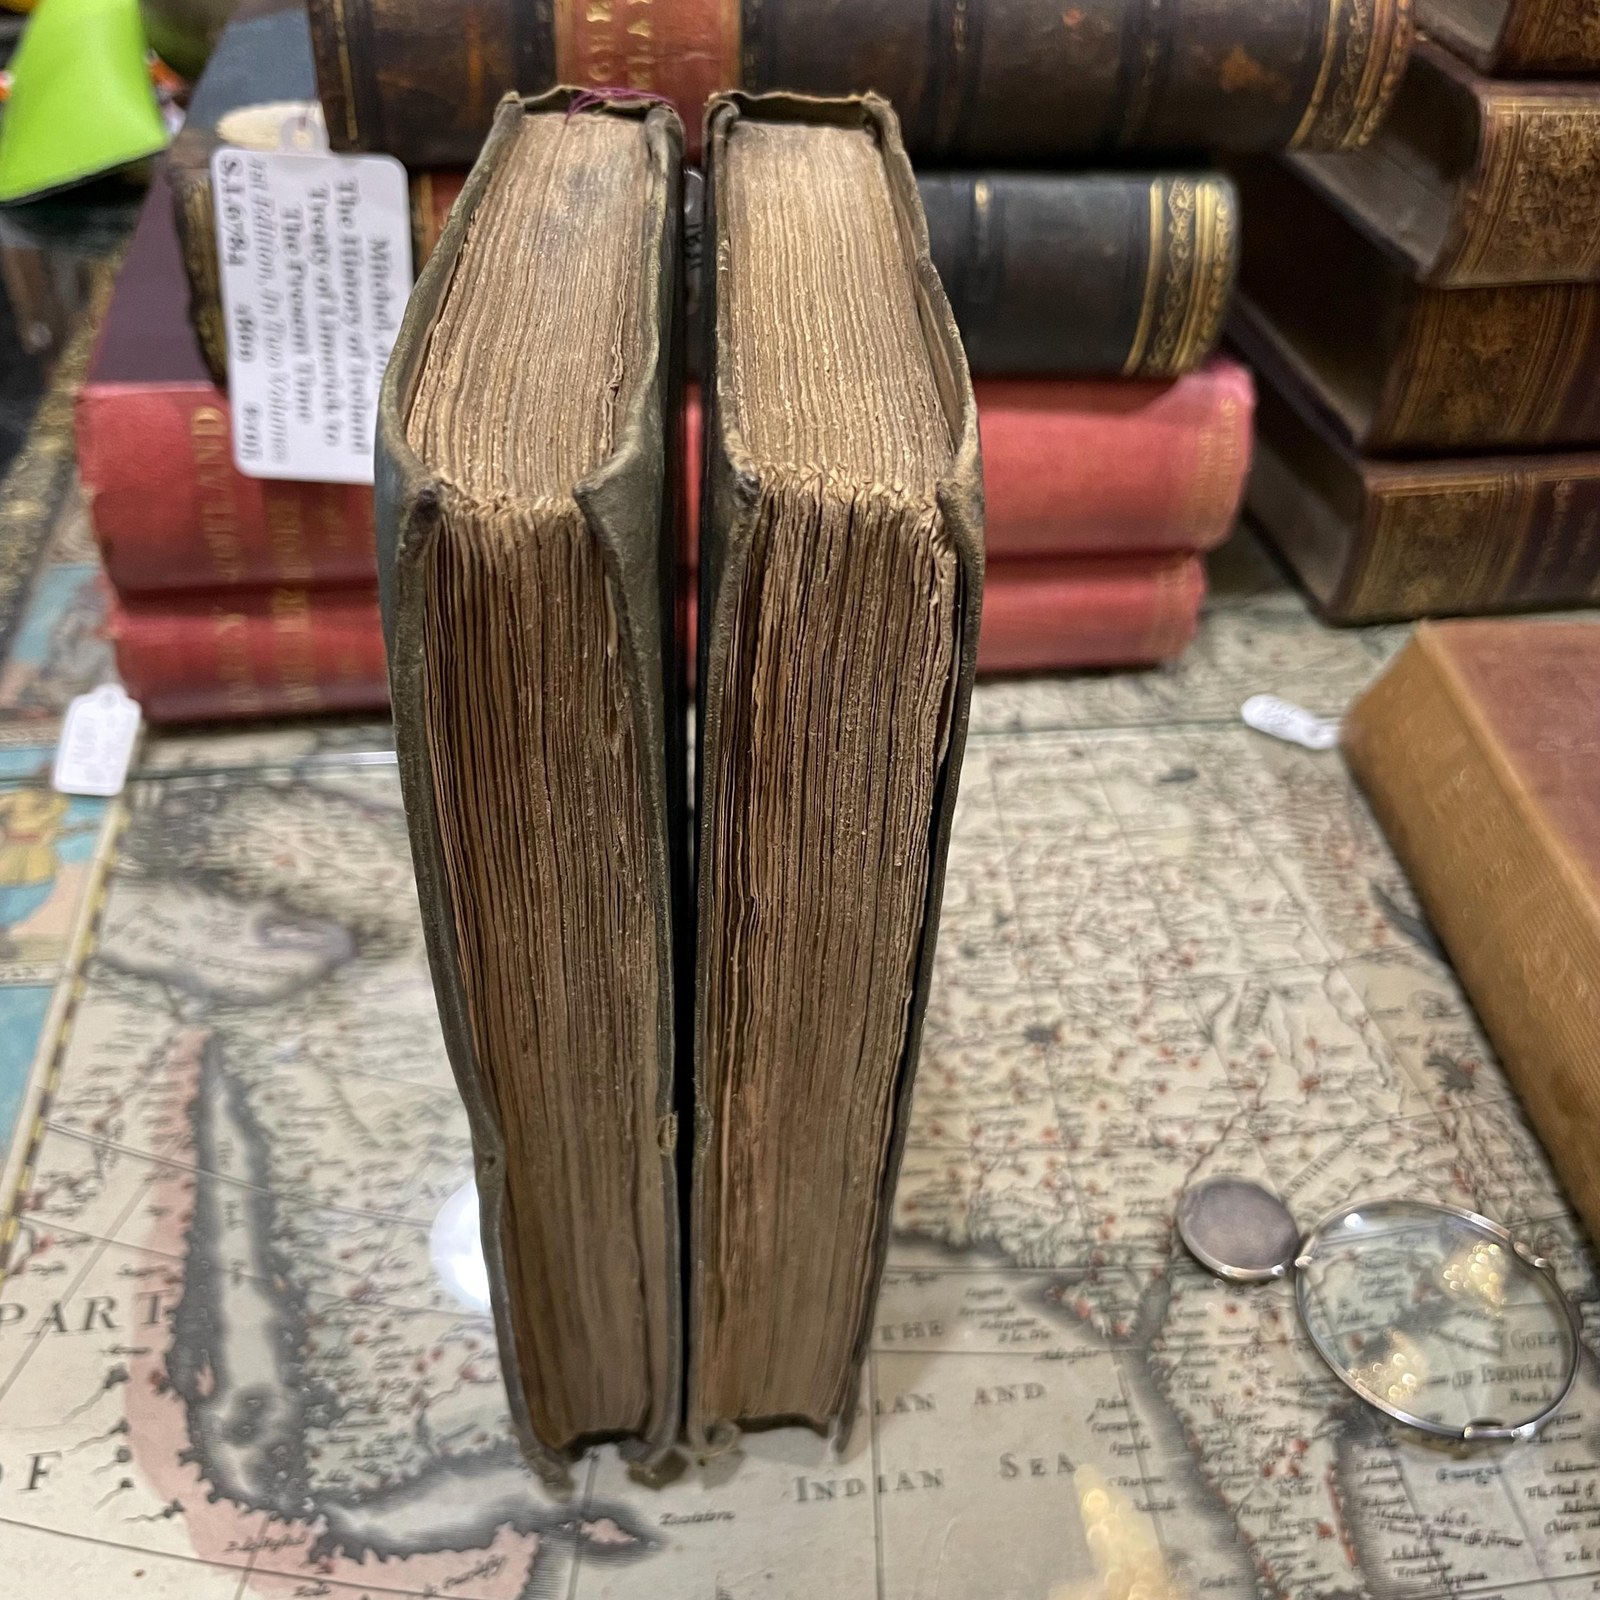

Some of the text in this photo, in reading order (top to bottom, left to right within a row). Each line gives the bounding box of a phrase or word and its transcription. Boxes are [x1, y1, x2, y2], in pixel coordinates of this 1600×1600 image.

[282, 207, 316, 424] The Present Time
[309, 186, 342, 446] Treaty of Limerick to
[337, 181, 371, 454] The History of Ireland
[0, 1290, 173, 1336] PART
[881, 1319, 945, 1343] THE
[974, 1382, 1046, 1407] AND
[0, 1450, 62, 1493] F
[793, 1467, 946, 1502] INDIAN
